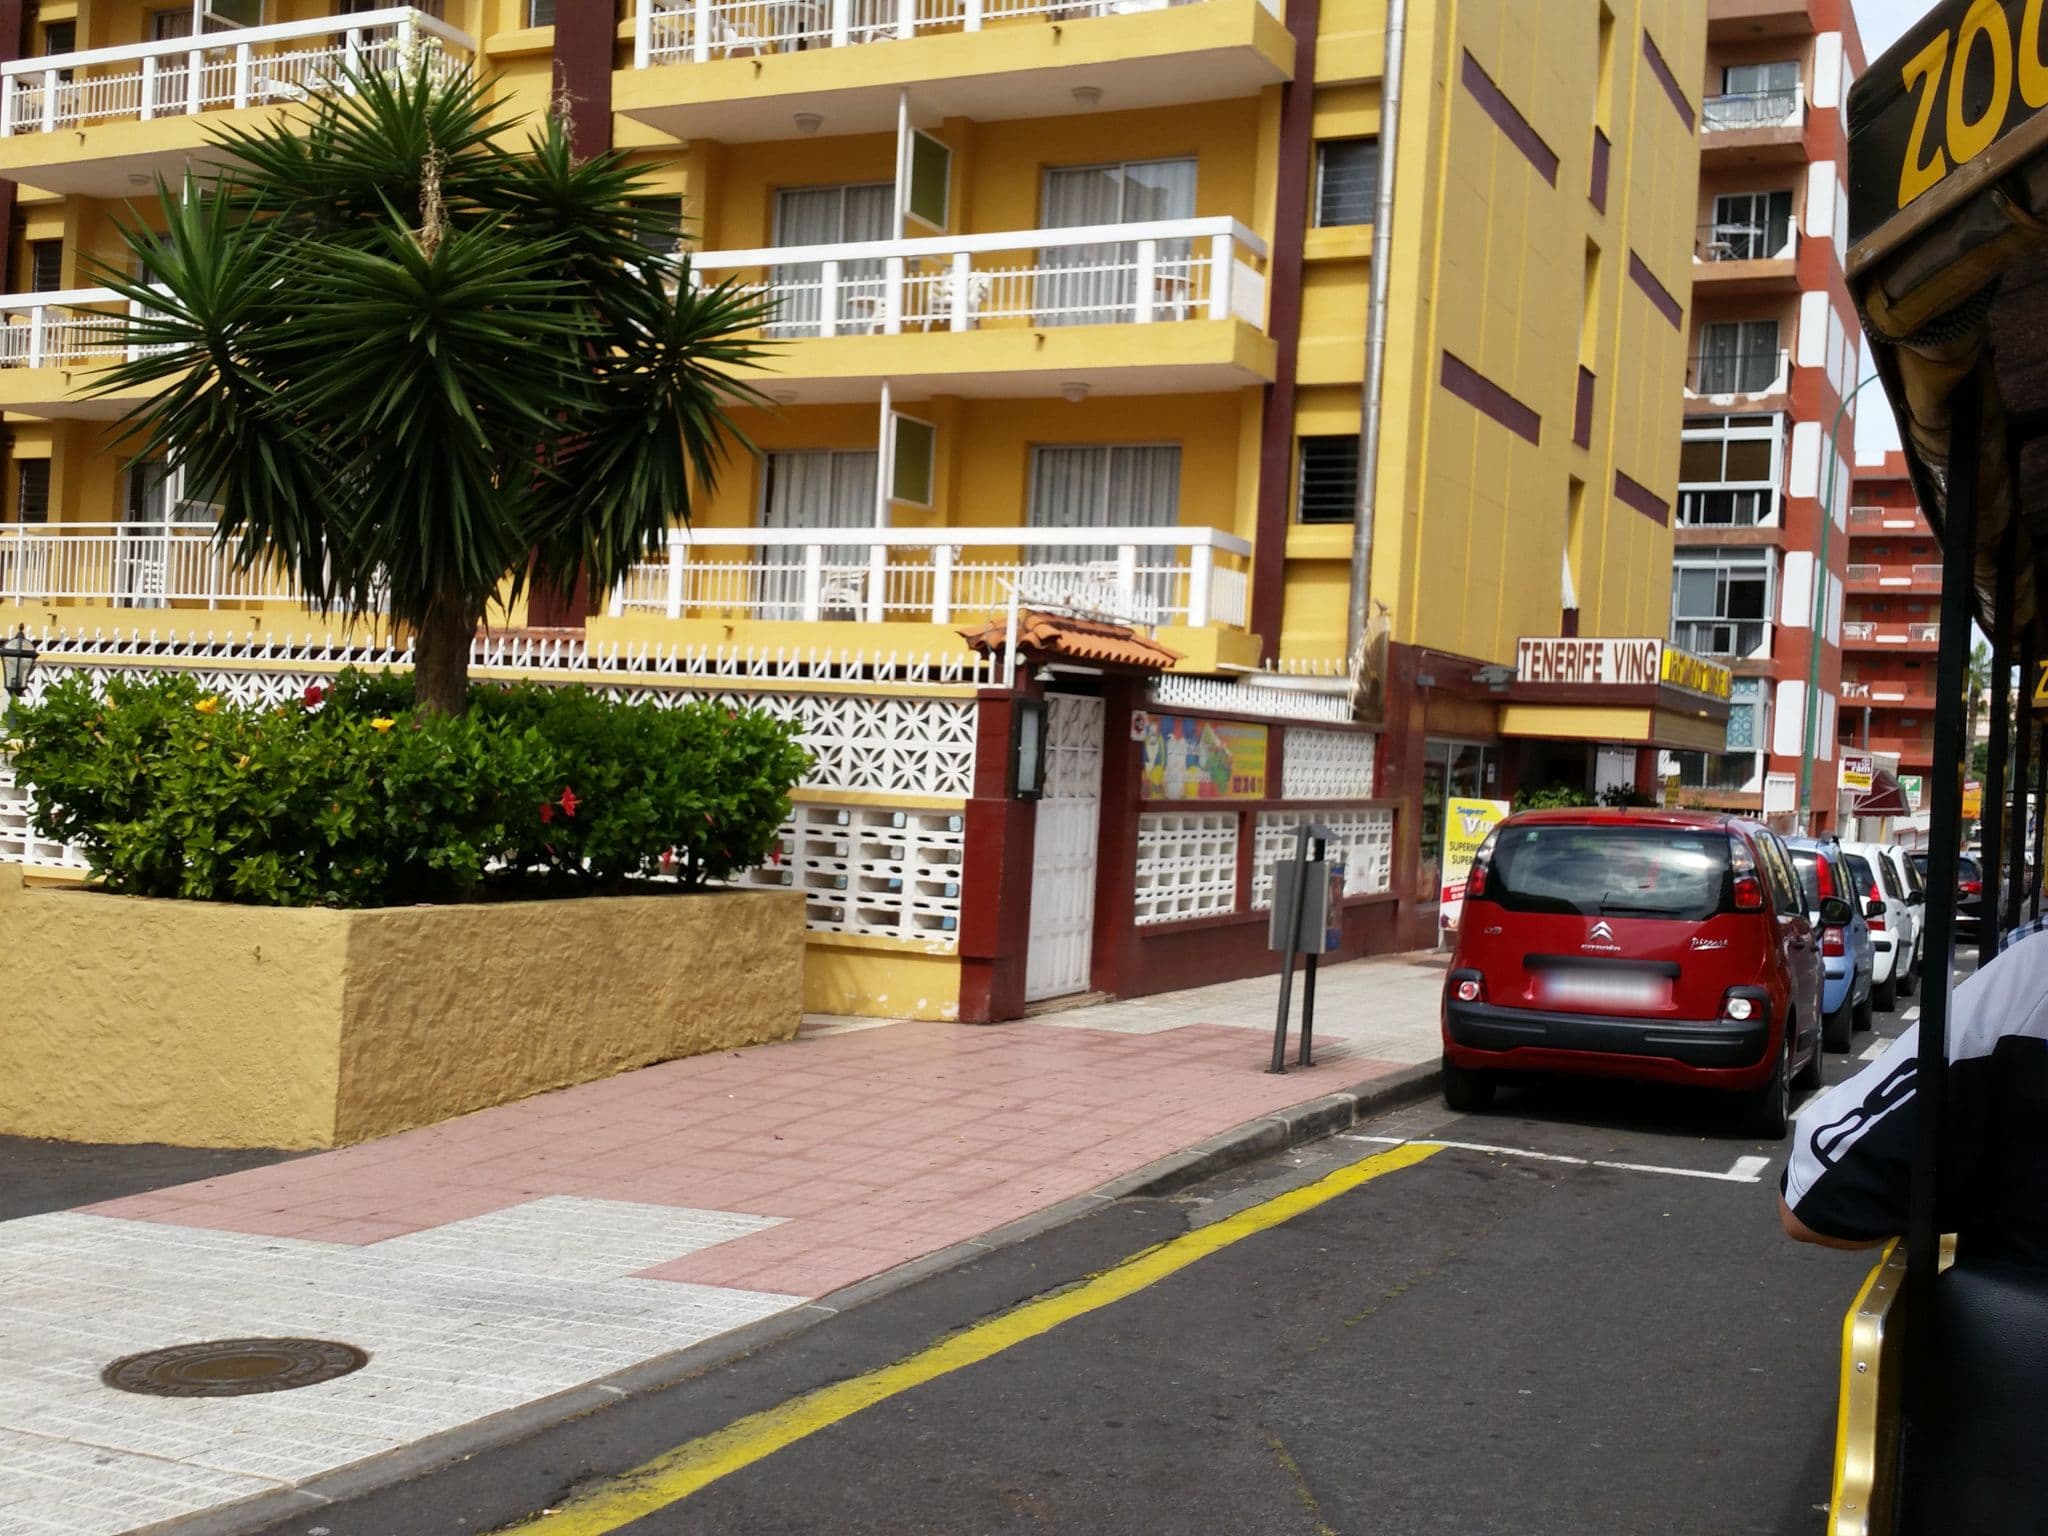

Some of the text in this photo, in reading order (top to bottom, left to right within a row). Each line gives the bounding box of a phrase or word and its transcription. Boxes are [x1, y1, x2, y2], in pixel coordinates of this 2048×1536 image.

[1520, 641, 1603, 681] TENERIFE
[1614, 641, 1657, 681] VING
[1456, 806, 1487, 816] Super
